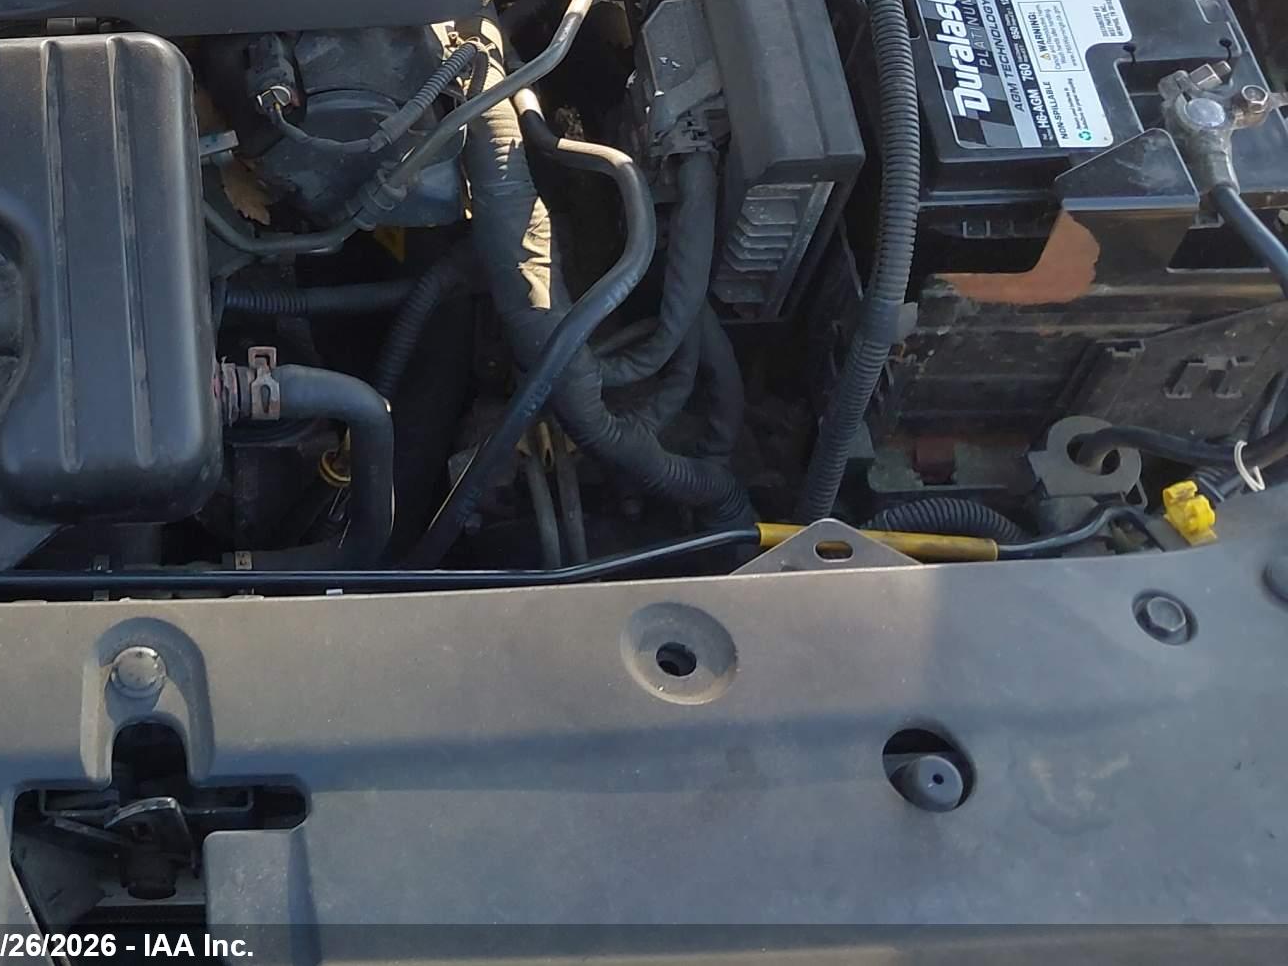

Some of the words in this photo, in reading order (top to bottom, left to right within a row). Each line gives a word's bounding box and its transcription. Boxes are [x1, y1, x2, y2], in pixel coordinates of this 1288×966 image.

[1027, 11, 1049, 53] WARNING:
[1018, 63, 1035, 82] 760
[1006, 82, 1026, 113] AGM
[1026, 89, 1052, 129] H6-AGM
[1042, 81, 1069, 140] NON-SPILLABLE
